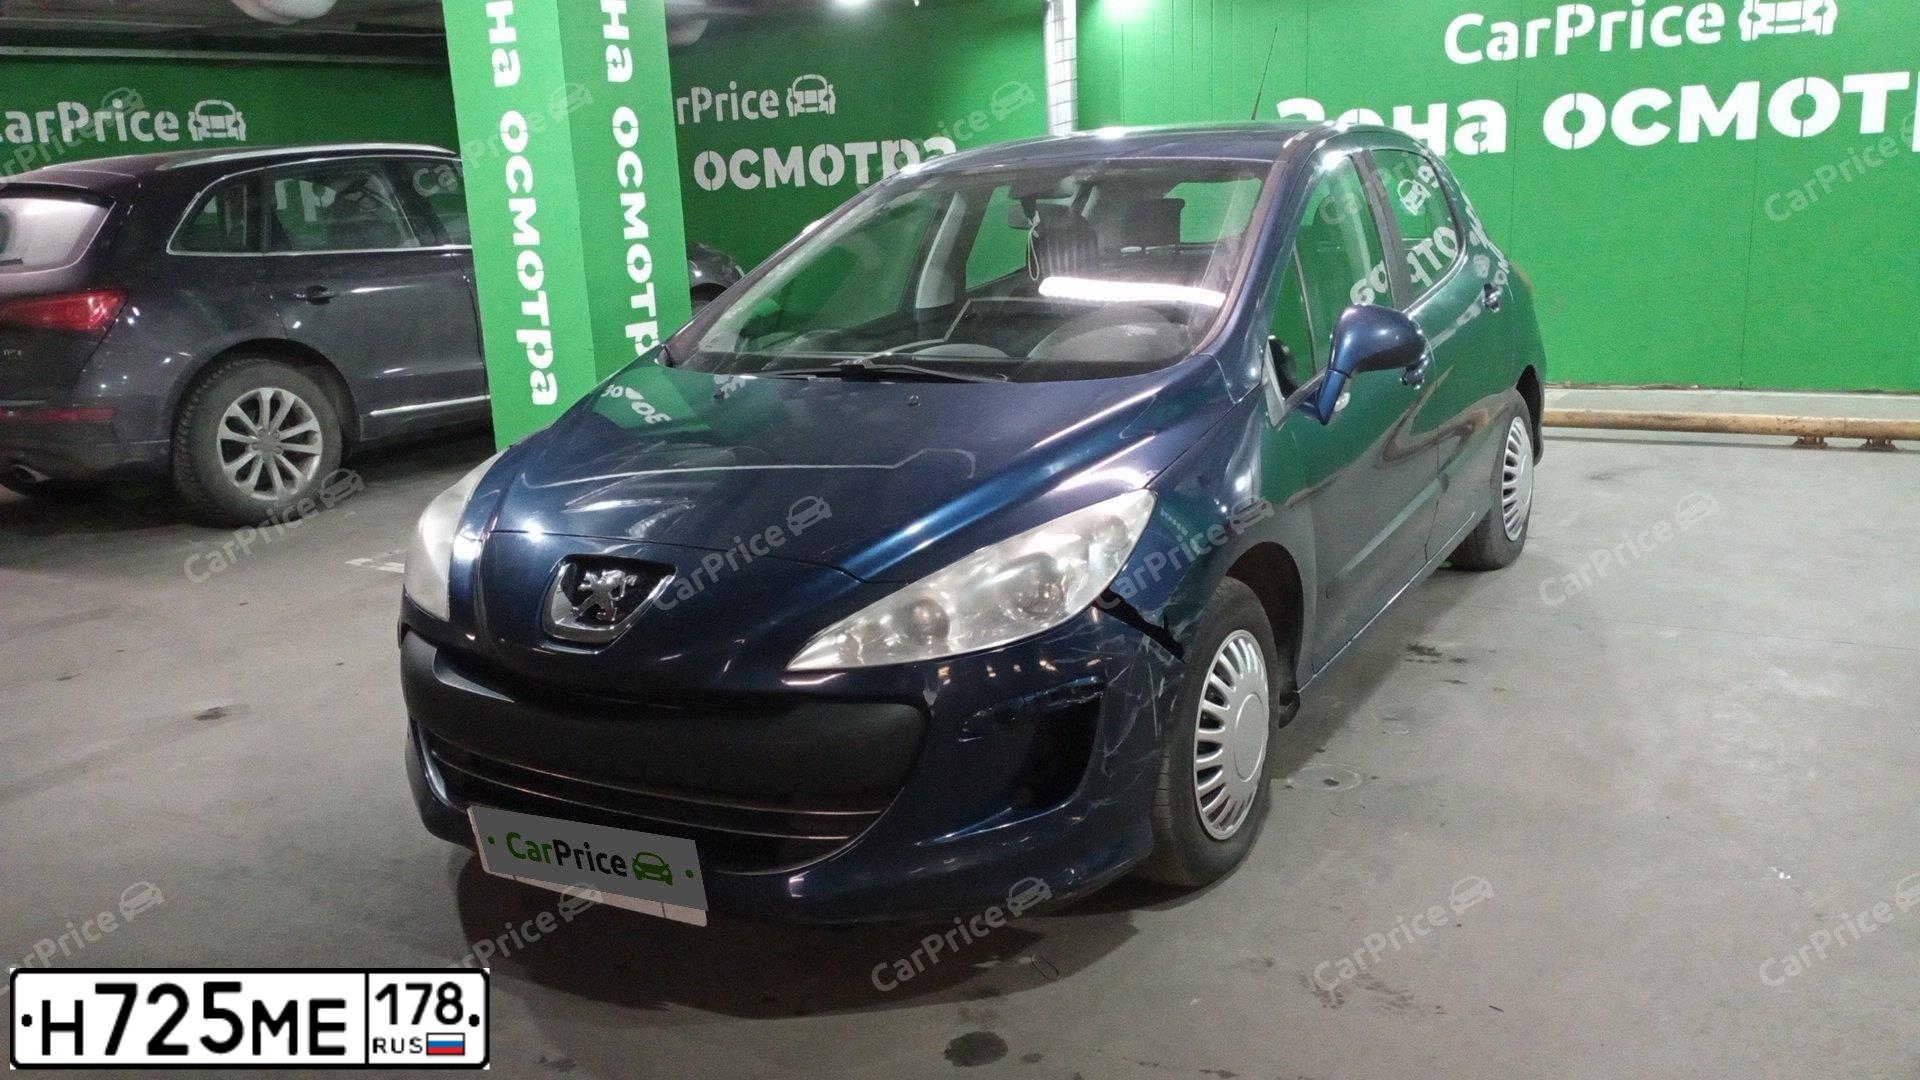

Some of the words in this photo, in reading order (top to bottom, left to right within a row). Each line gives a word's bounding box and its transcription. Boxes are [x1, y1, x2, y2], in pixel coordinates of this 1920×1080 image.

[1444, 0, 1726, 65] CarPrice
[0, 99, 180, 144] arPrice
[1276, 96, 1506, 157] на
[1543, 71, 1920, 150] осмот
[499, 110, 558, 406] осмотра
